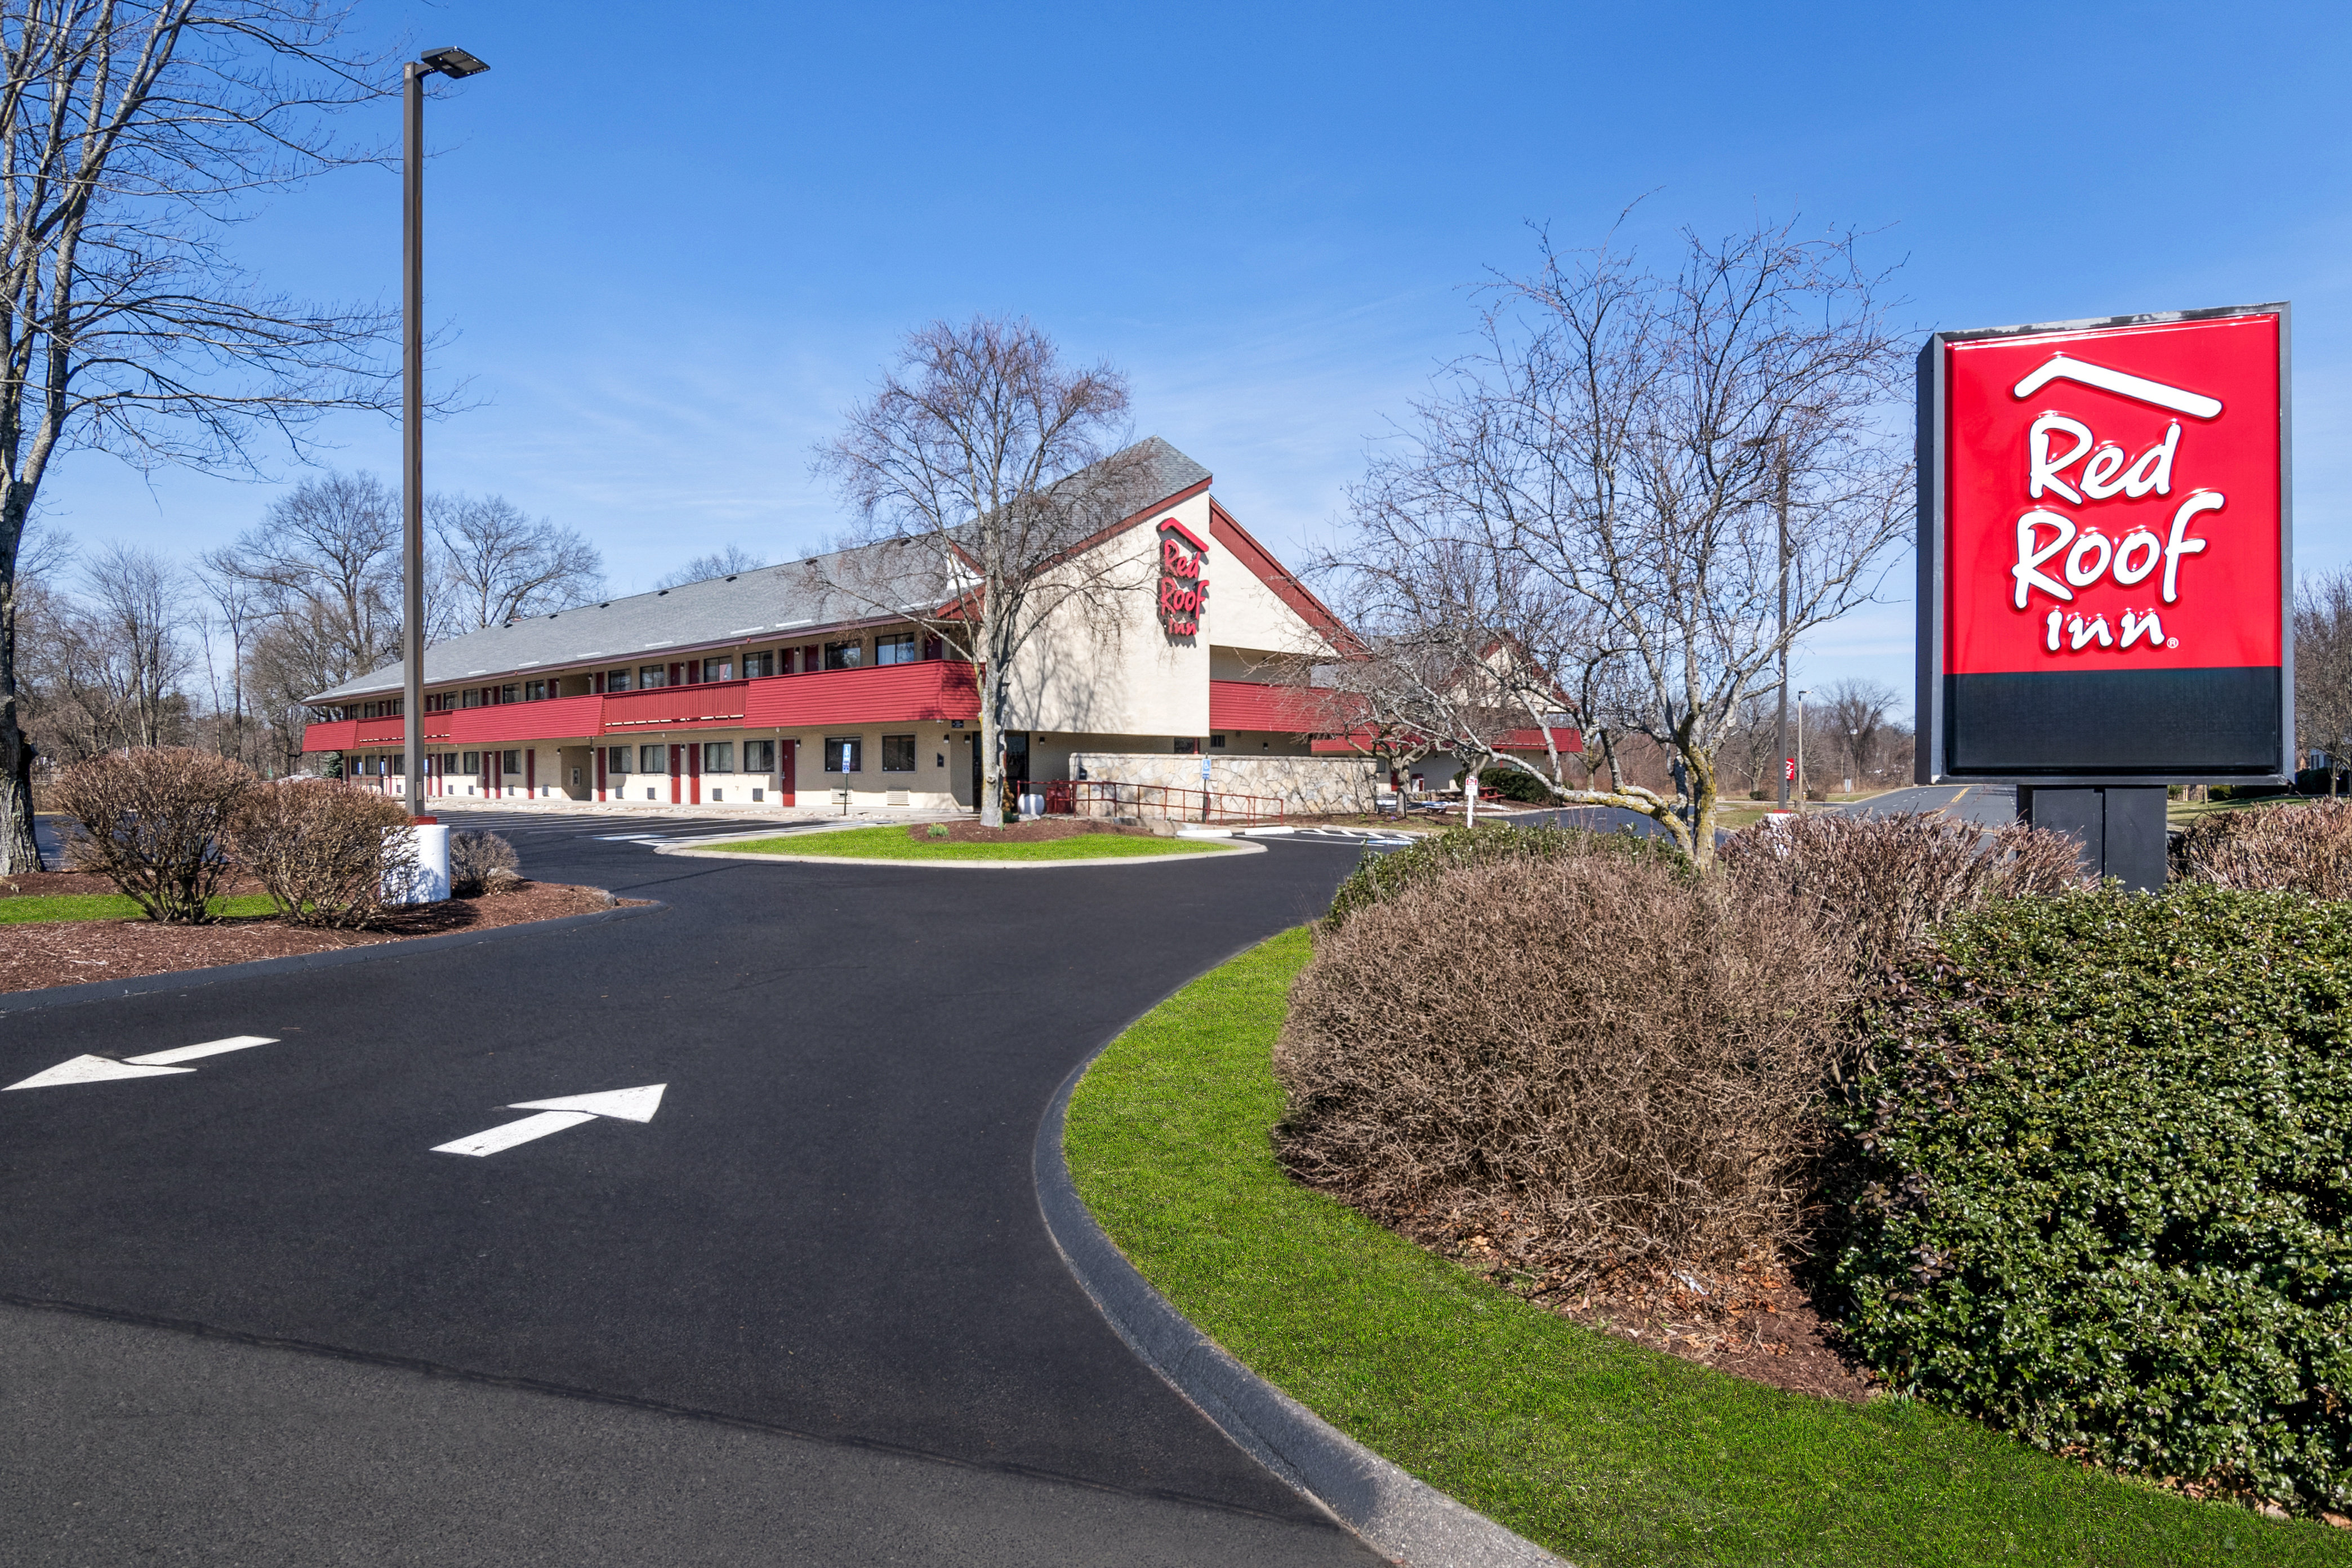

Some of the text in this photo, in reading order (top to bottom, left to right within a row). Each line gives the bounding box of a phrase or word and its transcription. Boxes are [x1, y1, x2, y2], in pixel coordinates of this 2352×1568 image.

[2029, 413, 2181, 505] Red
[1164, 539, 1201, 578] Red
[2011, 491, 2225, 609] Roof
[1160, 576, 1209, 620] Roof
